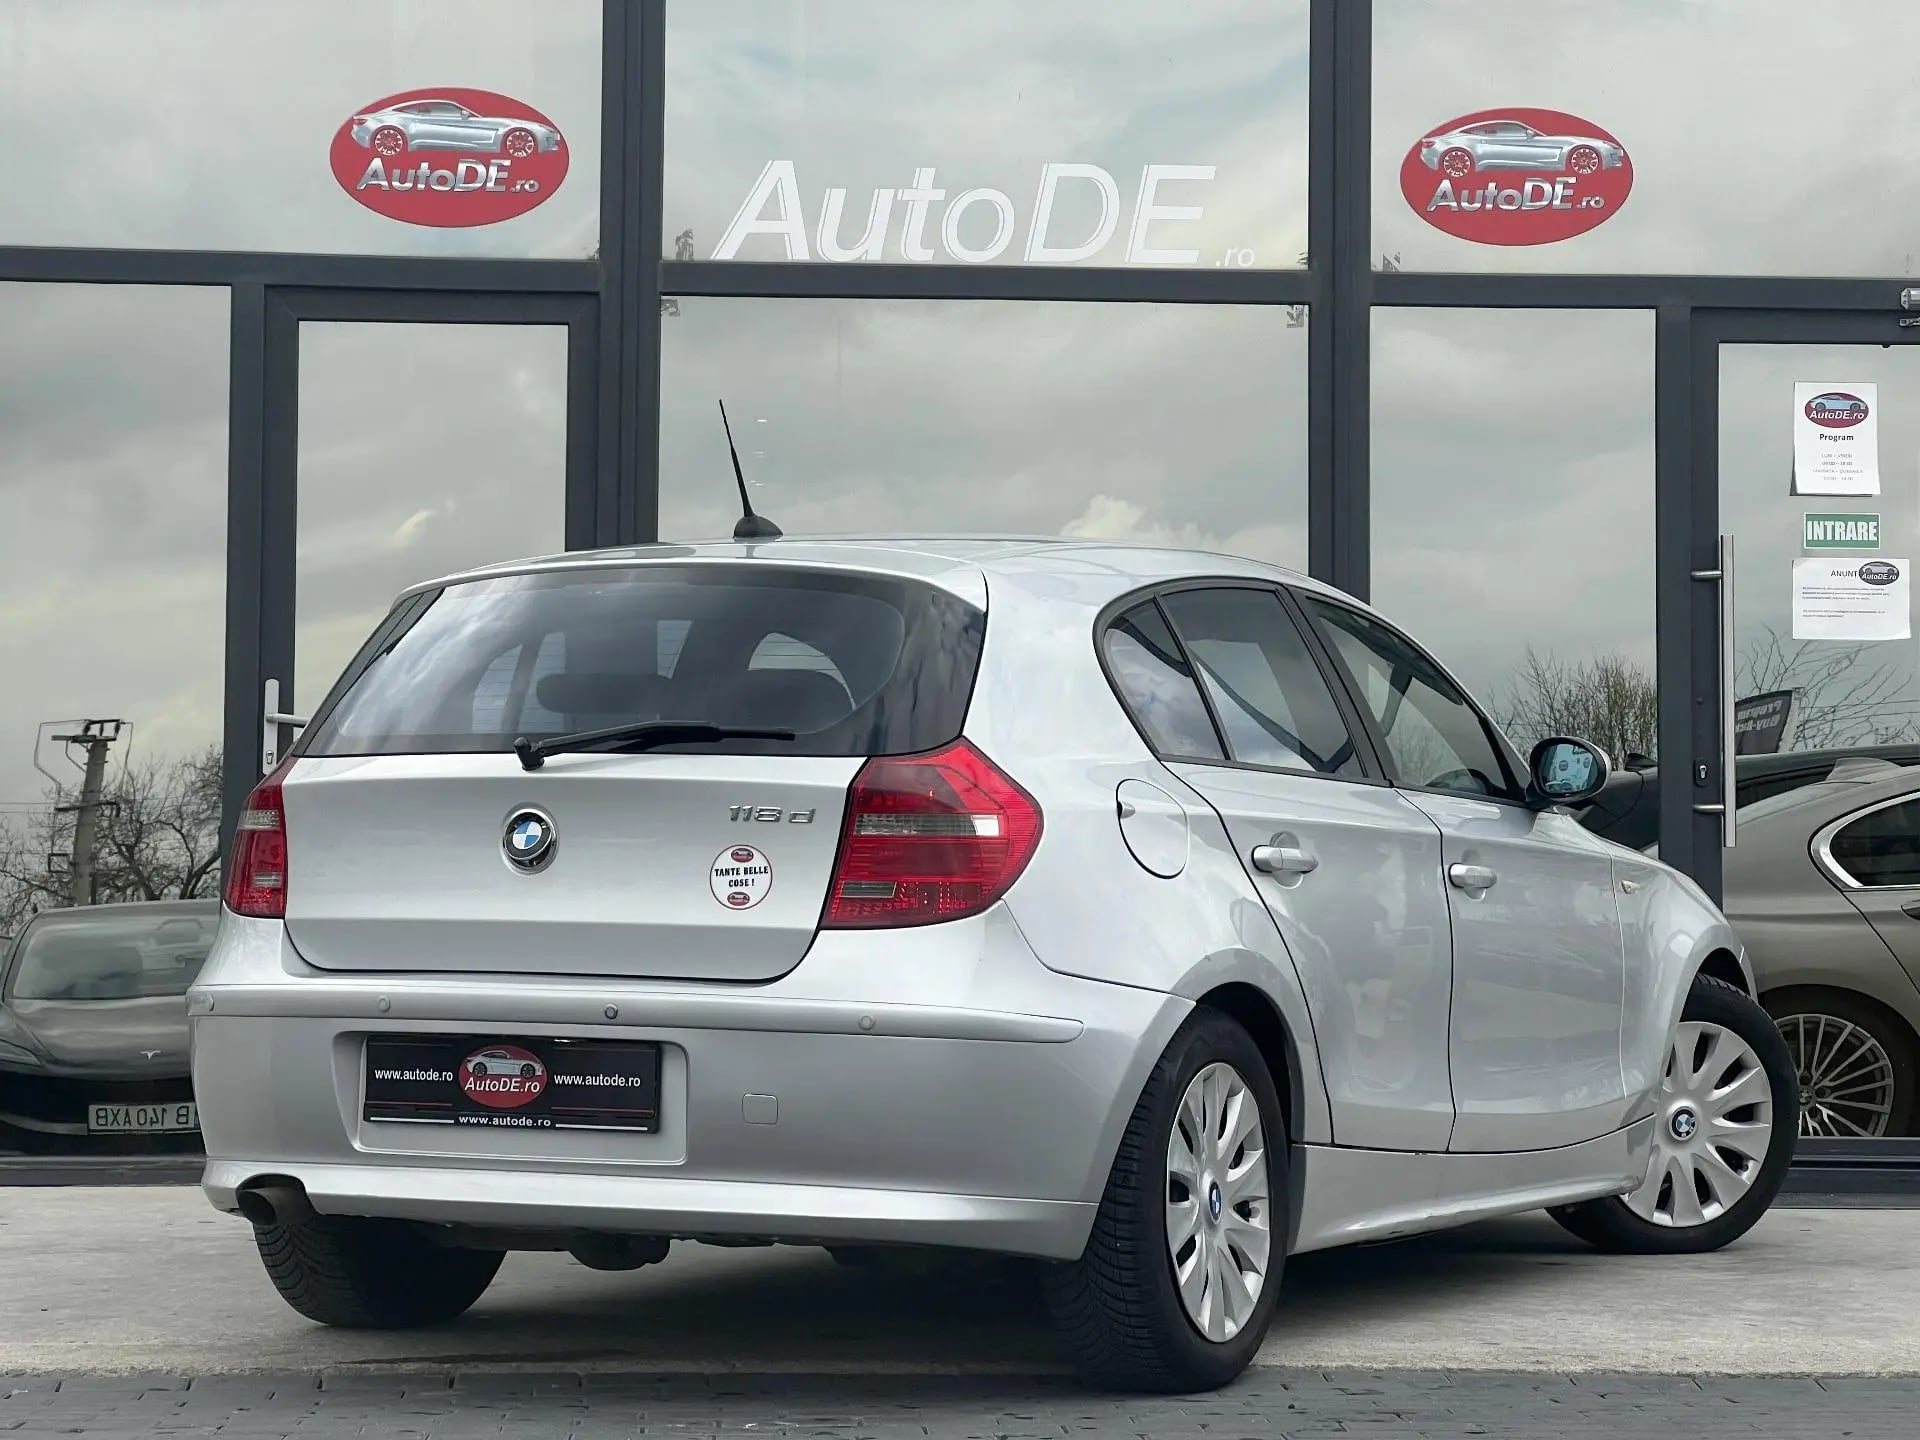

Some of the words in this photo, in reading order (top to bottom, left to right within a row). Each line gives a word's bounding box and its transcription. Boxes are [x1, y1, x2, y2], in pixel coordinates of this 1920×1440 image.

[1809, 410, 1865, 420] AutoDE.ro
[1819, 433, 1854, 443] Program
[1807, 520, 1878, 541] INTRARE
[714, 867, 741, 877] TANTE
[743, 866, 769, 875] BELLE
[728, 879, 750, 887] COSE
[374, 1068, 454, 1082] www.autode.ro
[553, 1073, 641, 1087] www.autode.ro
[464, 1077, 541, 1094] AutoDE.ro
[458, 1115, 552, 1127] www.autode.ro
